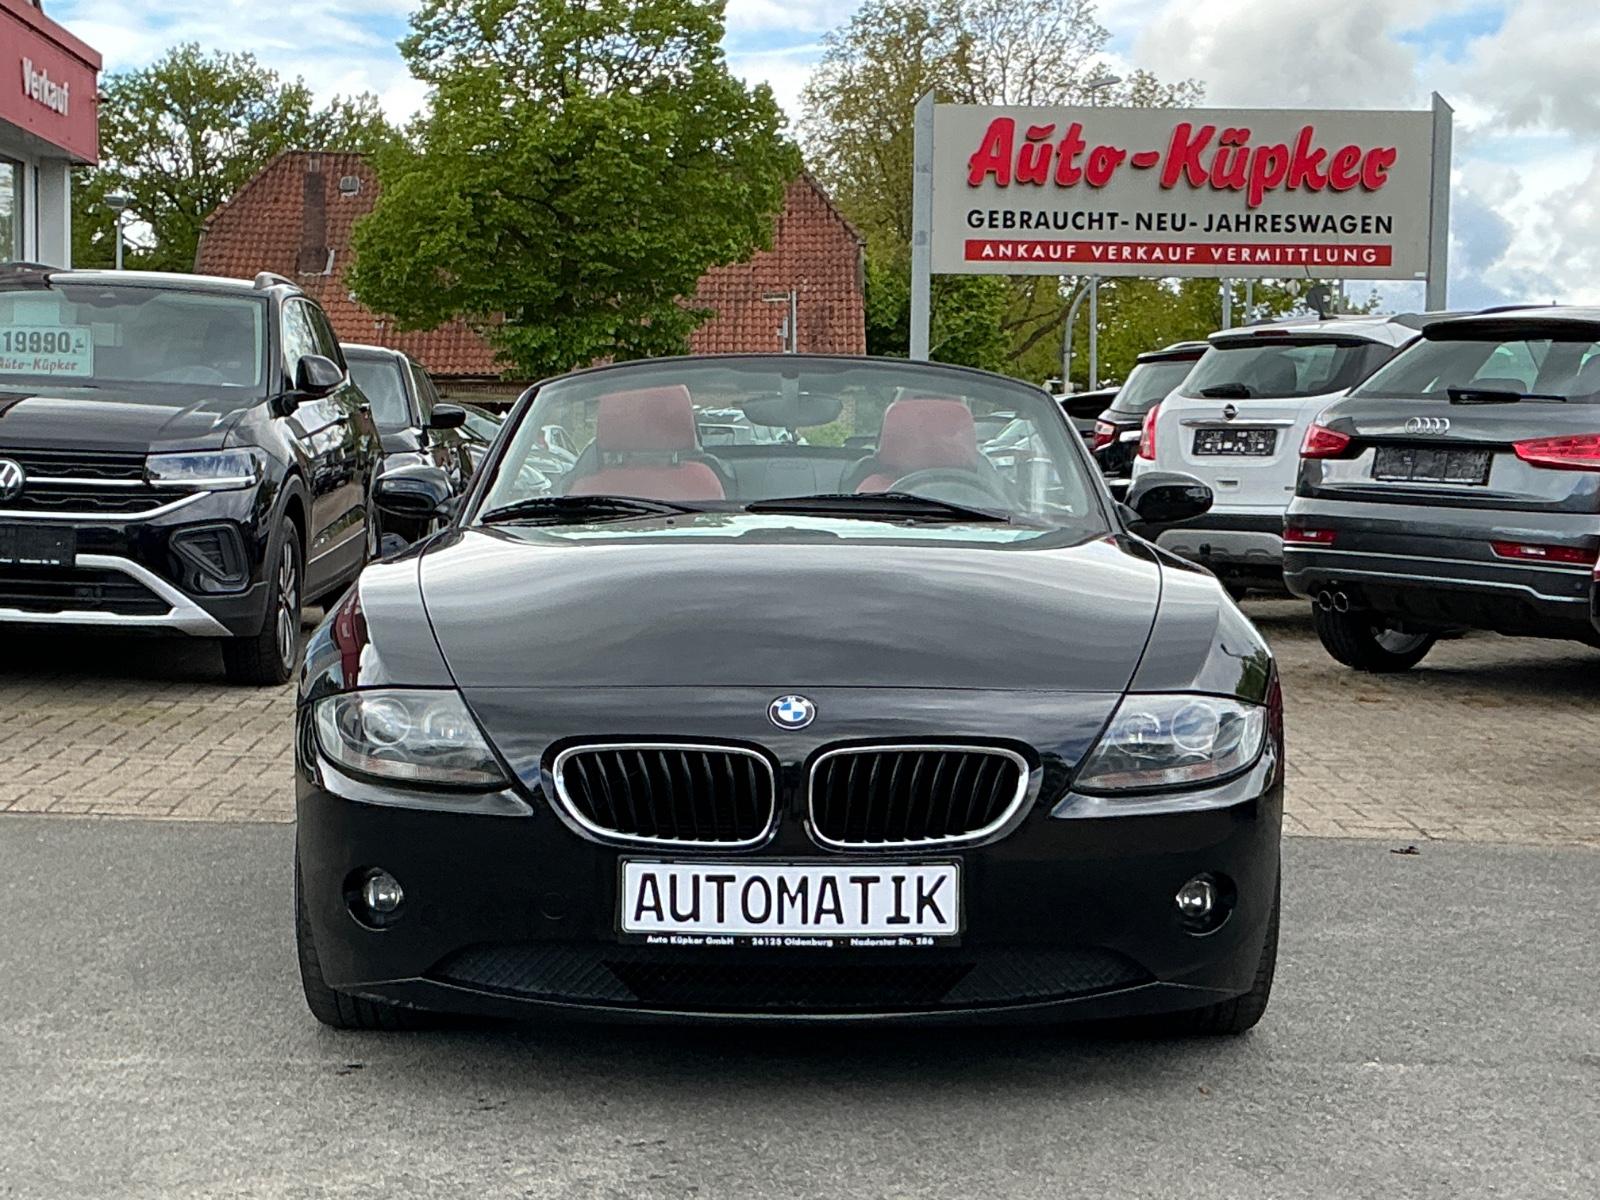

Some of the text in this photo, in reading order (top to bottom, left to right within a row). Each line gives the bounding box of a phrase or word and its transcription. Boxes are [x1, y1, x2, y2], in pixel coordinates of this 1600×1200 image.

[22, 56, 69, 116] Verkauf
[981, 244, 1377, 263] ANKAUF VERKAUF VERMITTLUNG
[633, 873, 947, 925] AUTOMATIK
[646, 935, 668, 944] Auto
[705, 936, 734, 946] GmbH
[784, 937, 834, 948] Oldenburg
